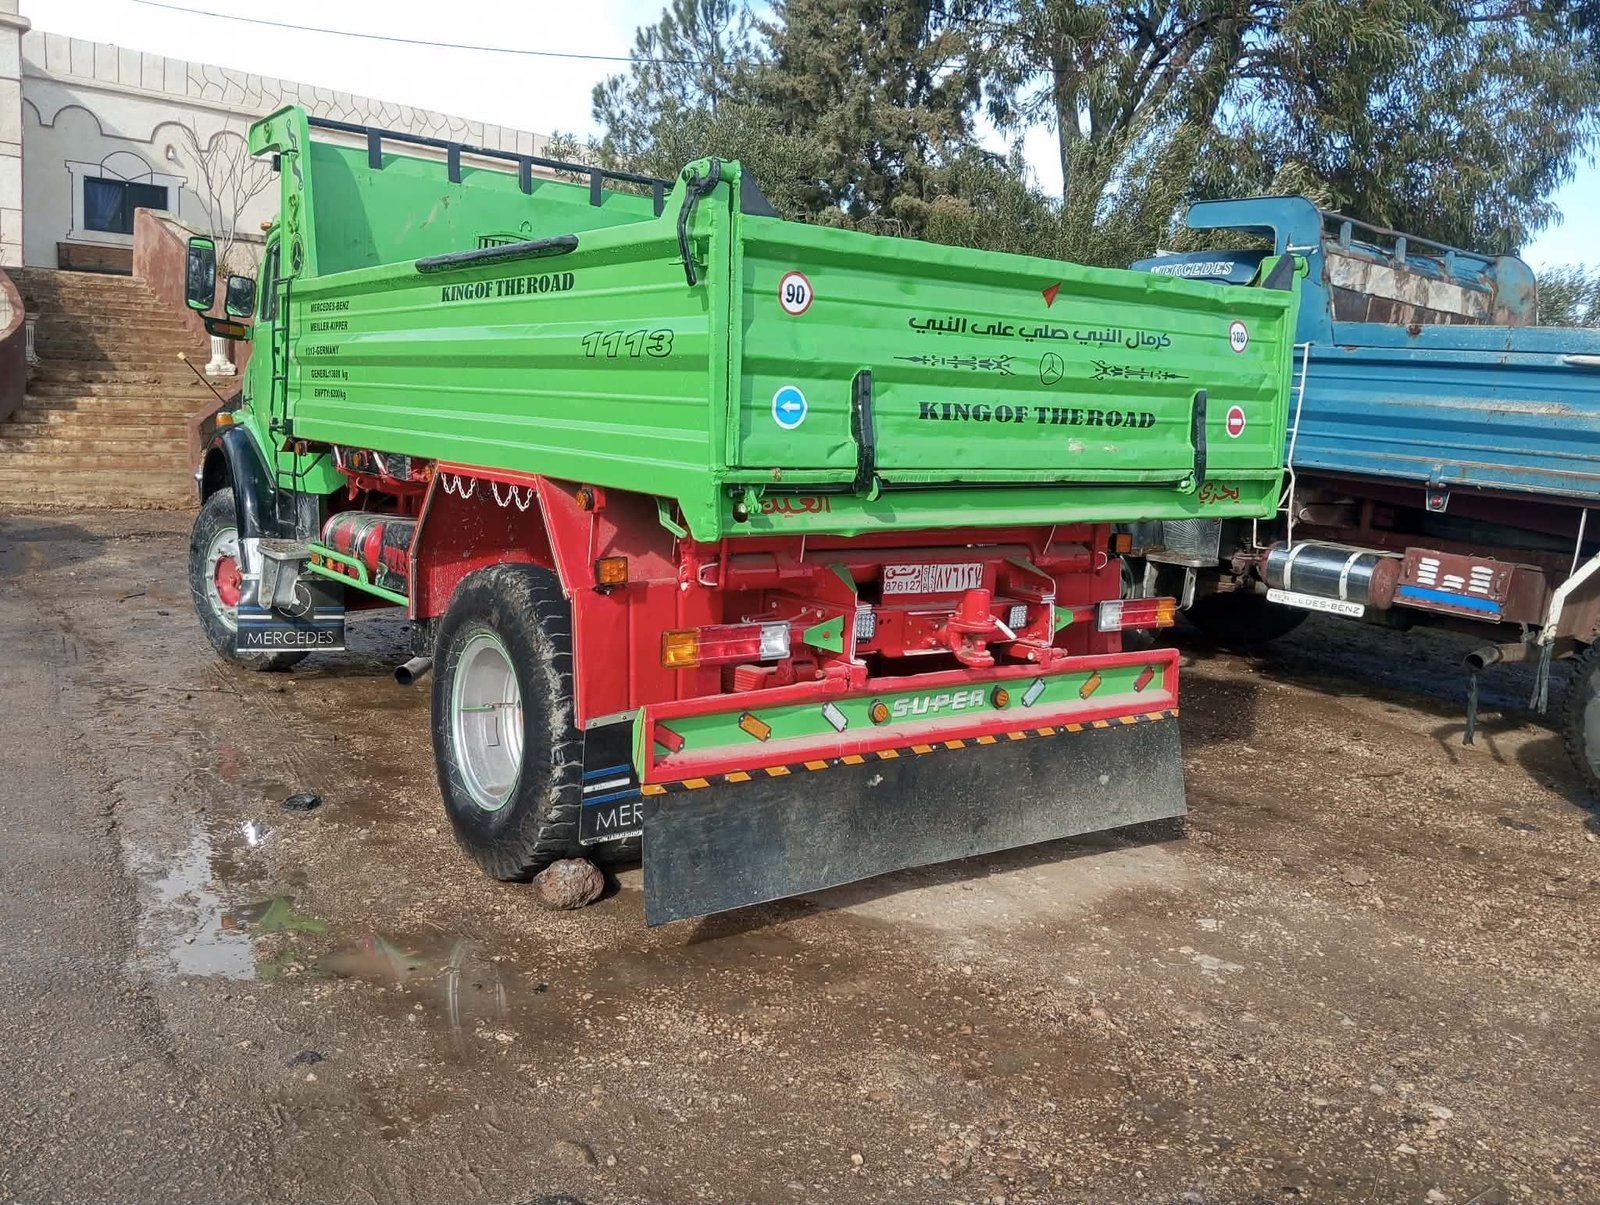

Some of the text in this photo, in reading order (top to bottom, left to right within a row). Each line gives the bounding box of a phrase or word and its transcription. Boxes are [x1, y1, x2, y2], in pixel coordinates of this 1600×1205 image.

[1150, 261, 1235, 277] MERCEDES
[785, 283, 806, 305] 90
[310, 300, 350, 312] MERCEDES-BENZ
[908, 315, 967, 336] النبي
[970, 320, 1015, 337] على
[581, 328, 675, 358] 1113
[1072, 329, 1122, 349] النبي
[1125, 331, 1172, 350] كرمال
[1232, 331, 1246, 344] 100
[884, 580, 921, 592] 876127
[246, 630, 334, 646] MERCEDES
[891, 688, 986, 718] SUPER
